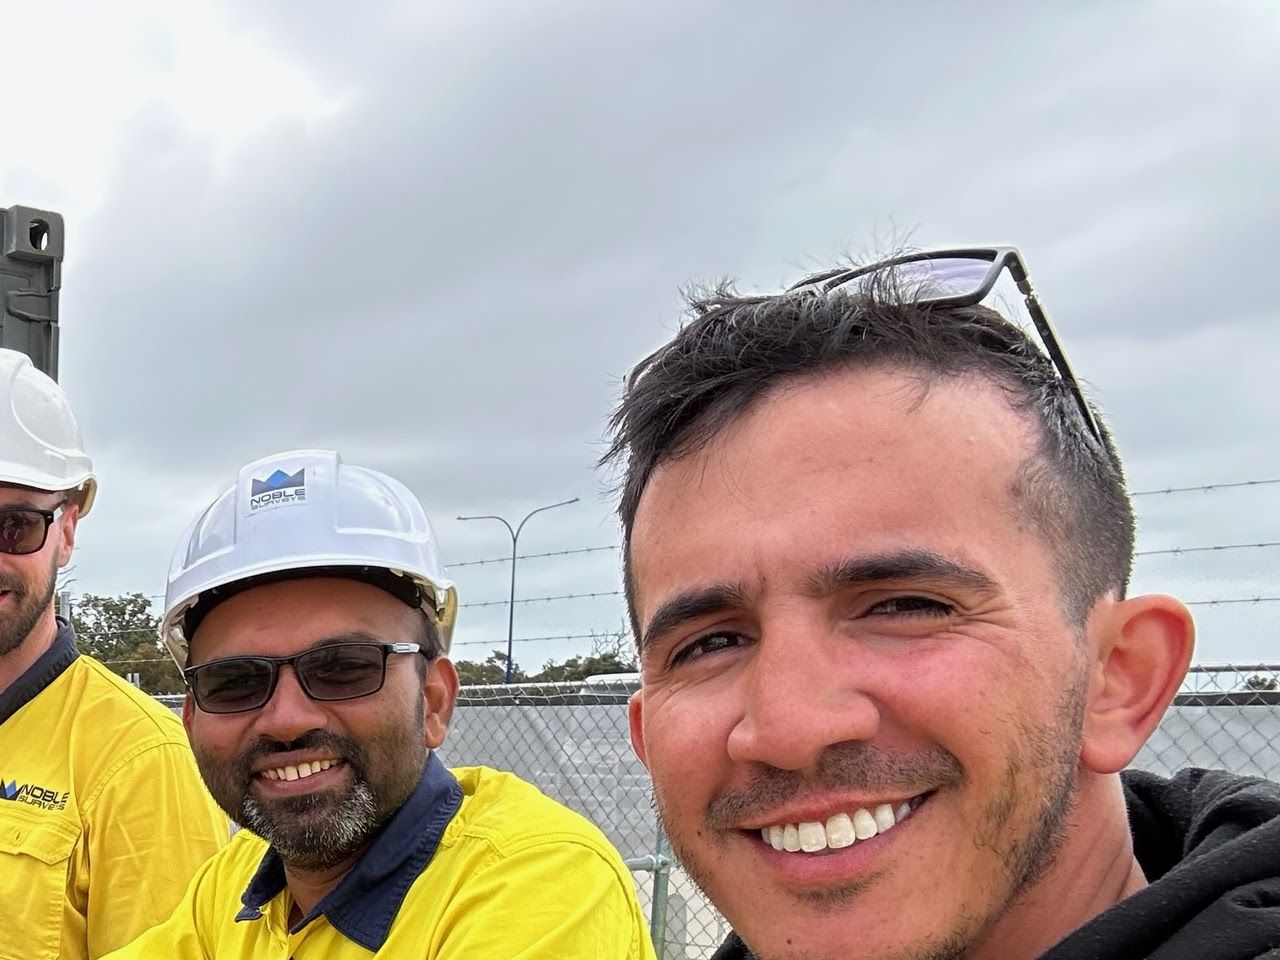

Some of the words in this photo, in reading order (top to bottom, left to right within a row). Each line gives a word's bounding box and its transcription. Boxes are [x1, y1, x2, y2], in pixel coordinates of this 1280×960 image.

[250, 488, 306, 507] NOBLE
[250, 496, 306, 511] SURVEYS
[20, 784, 70, 804] NOBLE
